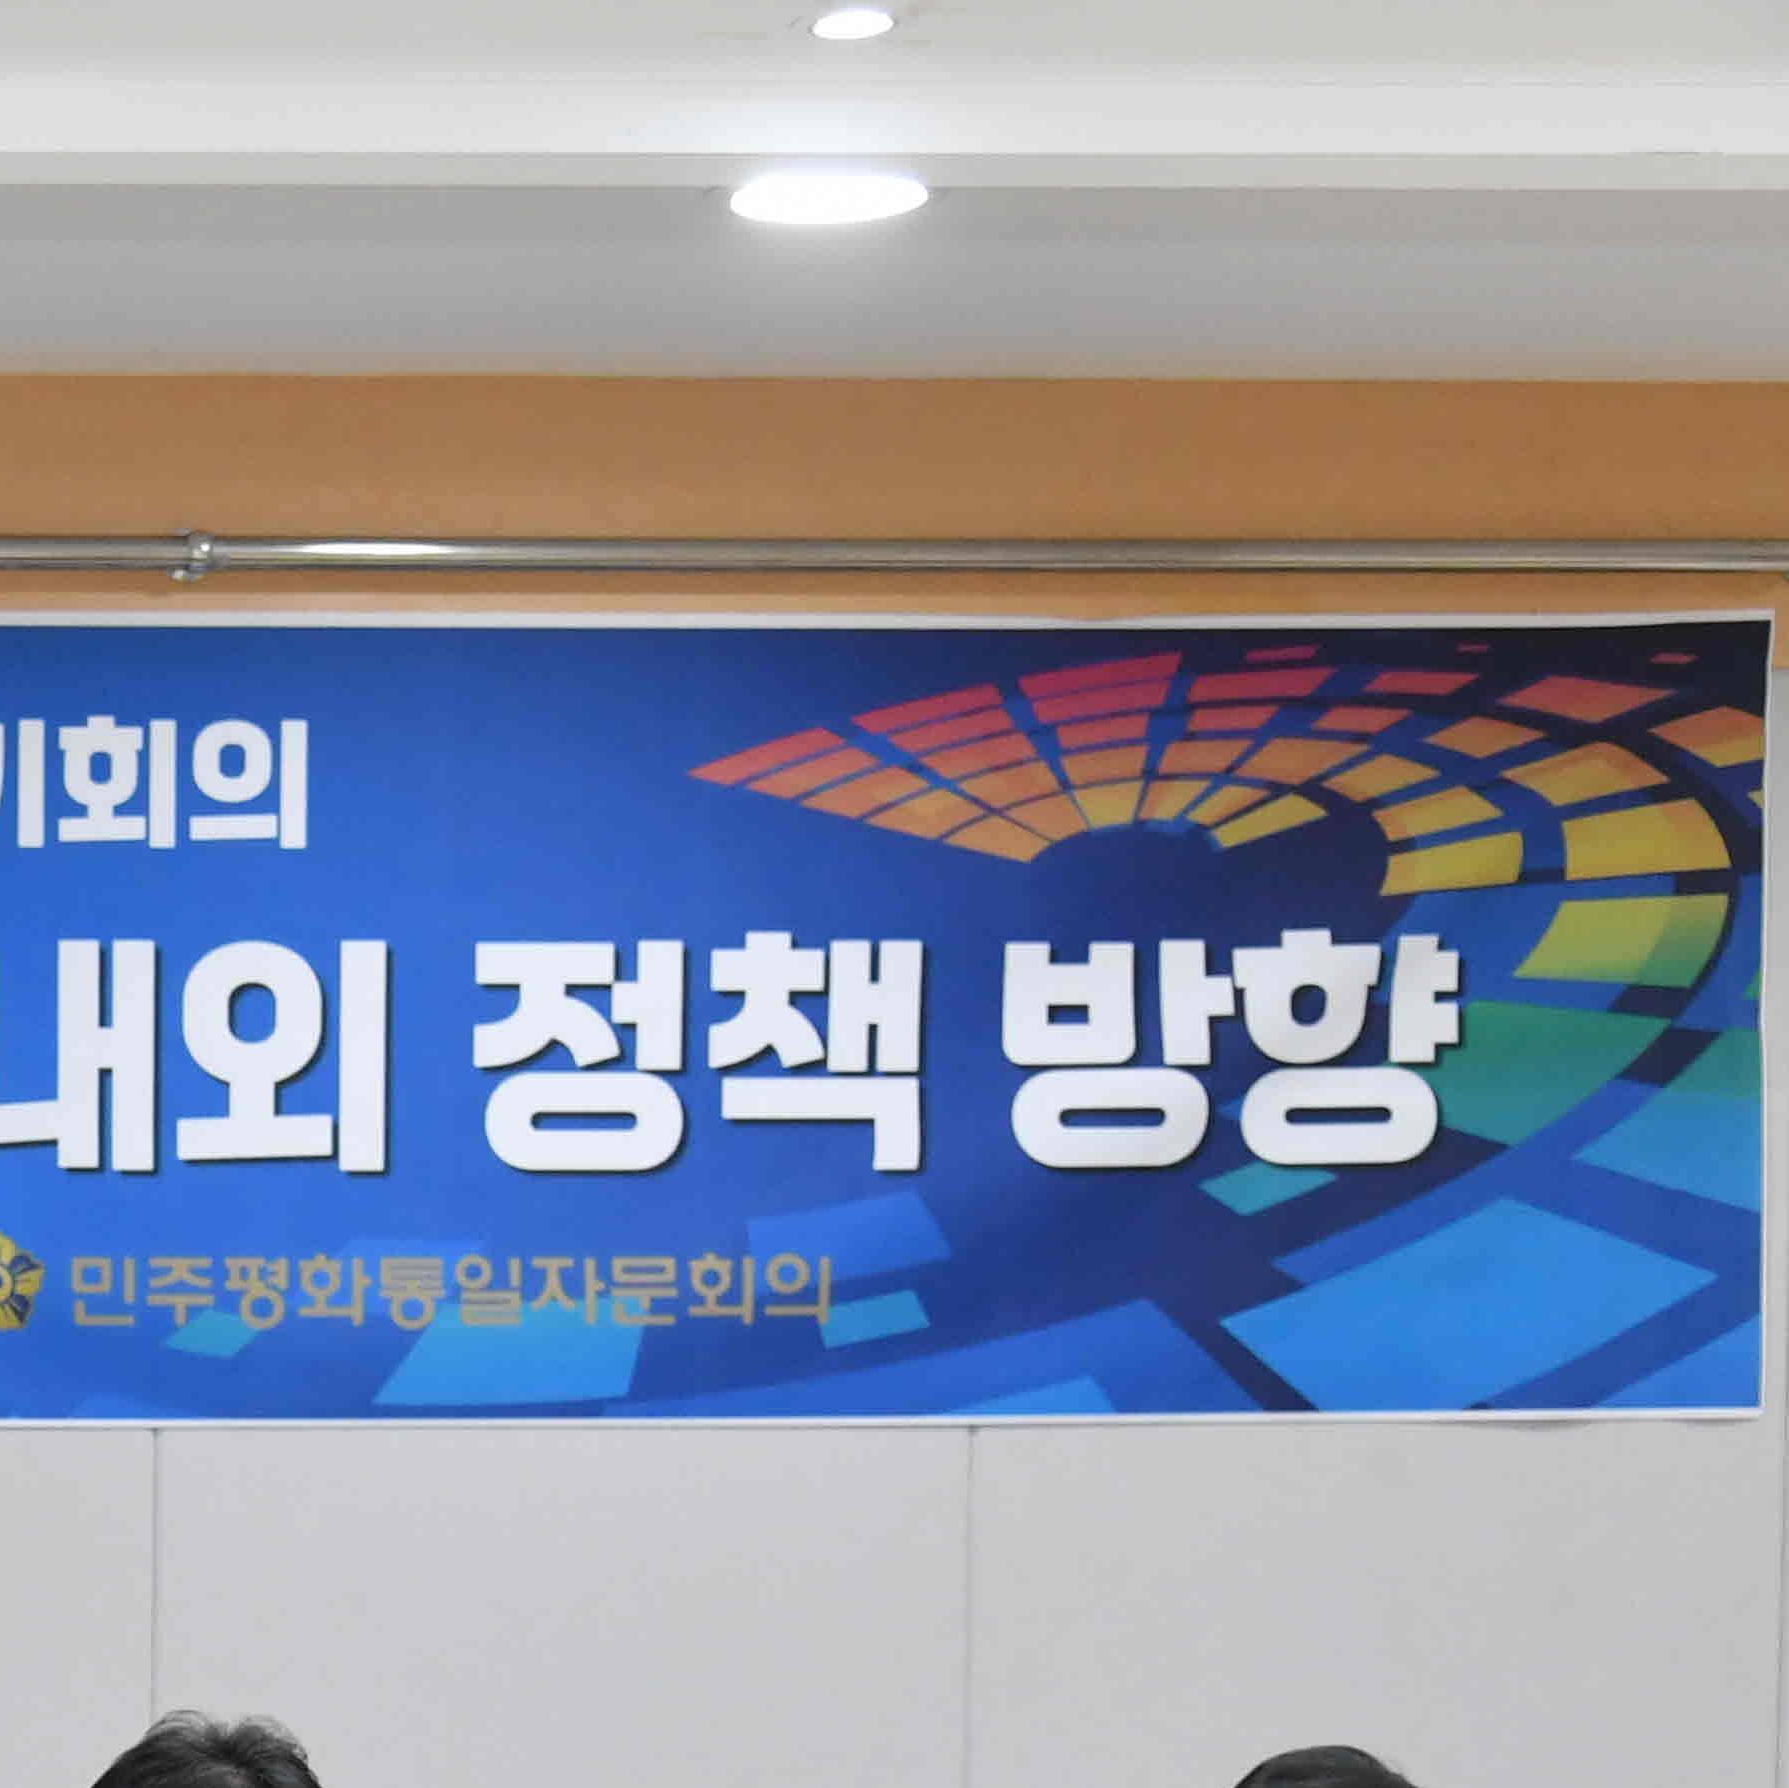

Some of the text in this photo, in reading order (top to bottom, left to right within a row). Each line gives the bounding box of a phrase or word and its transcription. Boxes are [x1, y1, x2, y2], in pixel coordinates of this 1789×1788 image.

[473, 931, 922, 1171] 정책
[1002, 929, 1459, 1167] 방향
[68, 1252, 834, 1330] 민주평화통일자문회의
